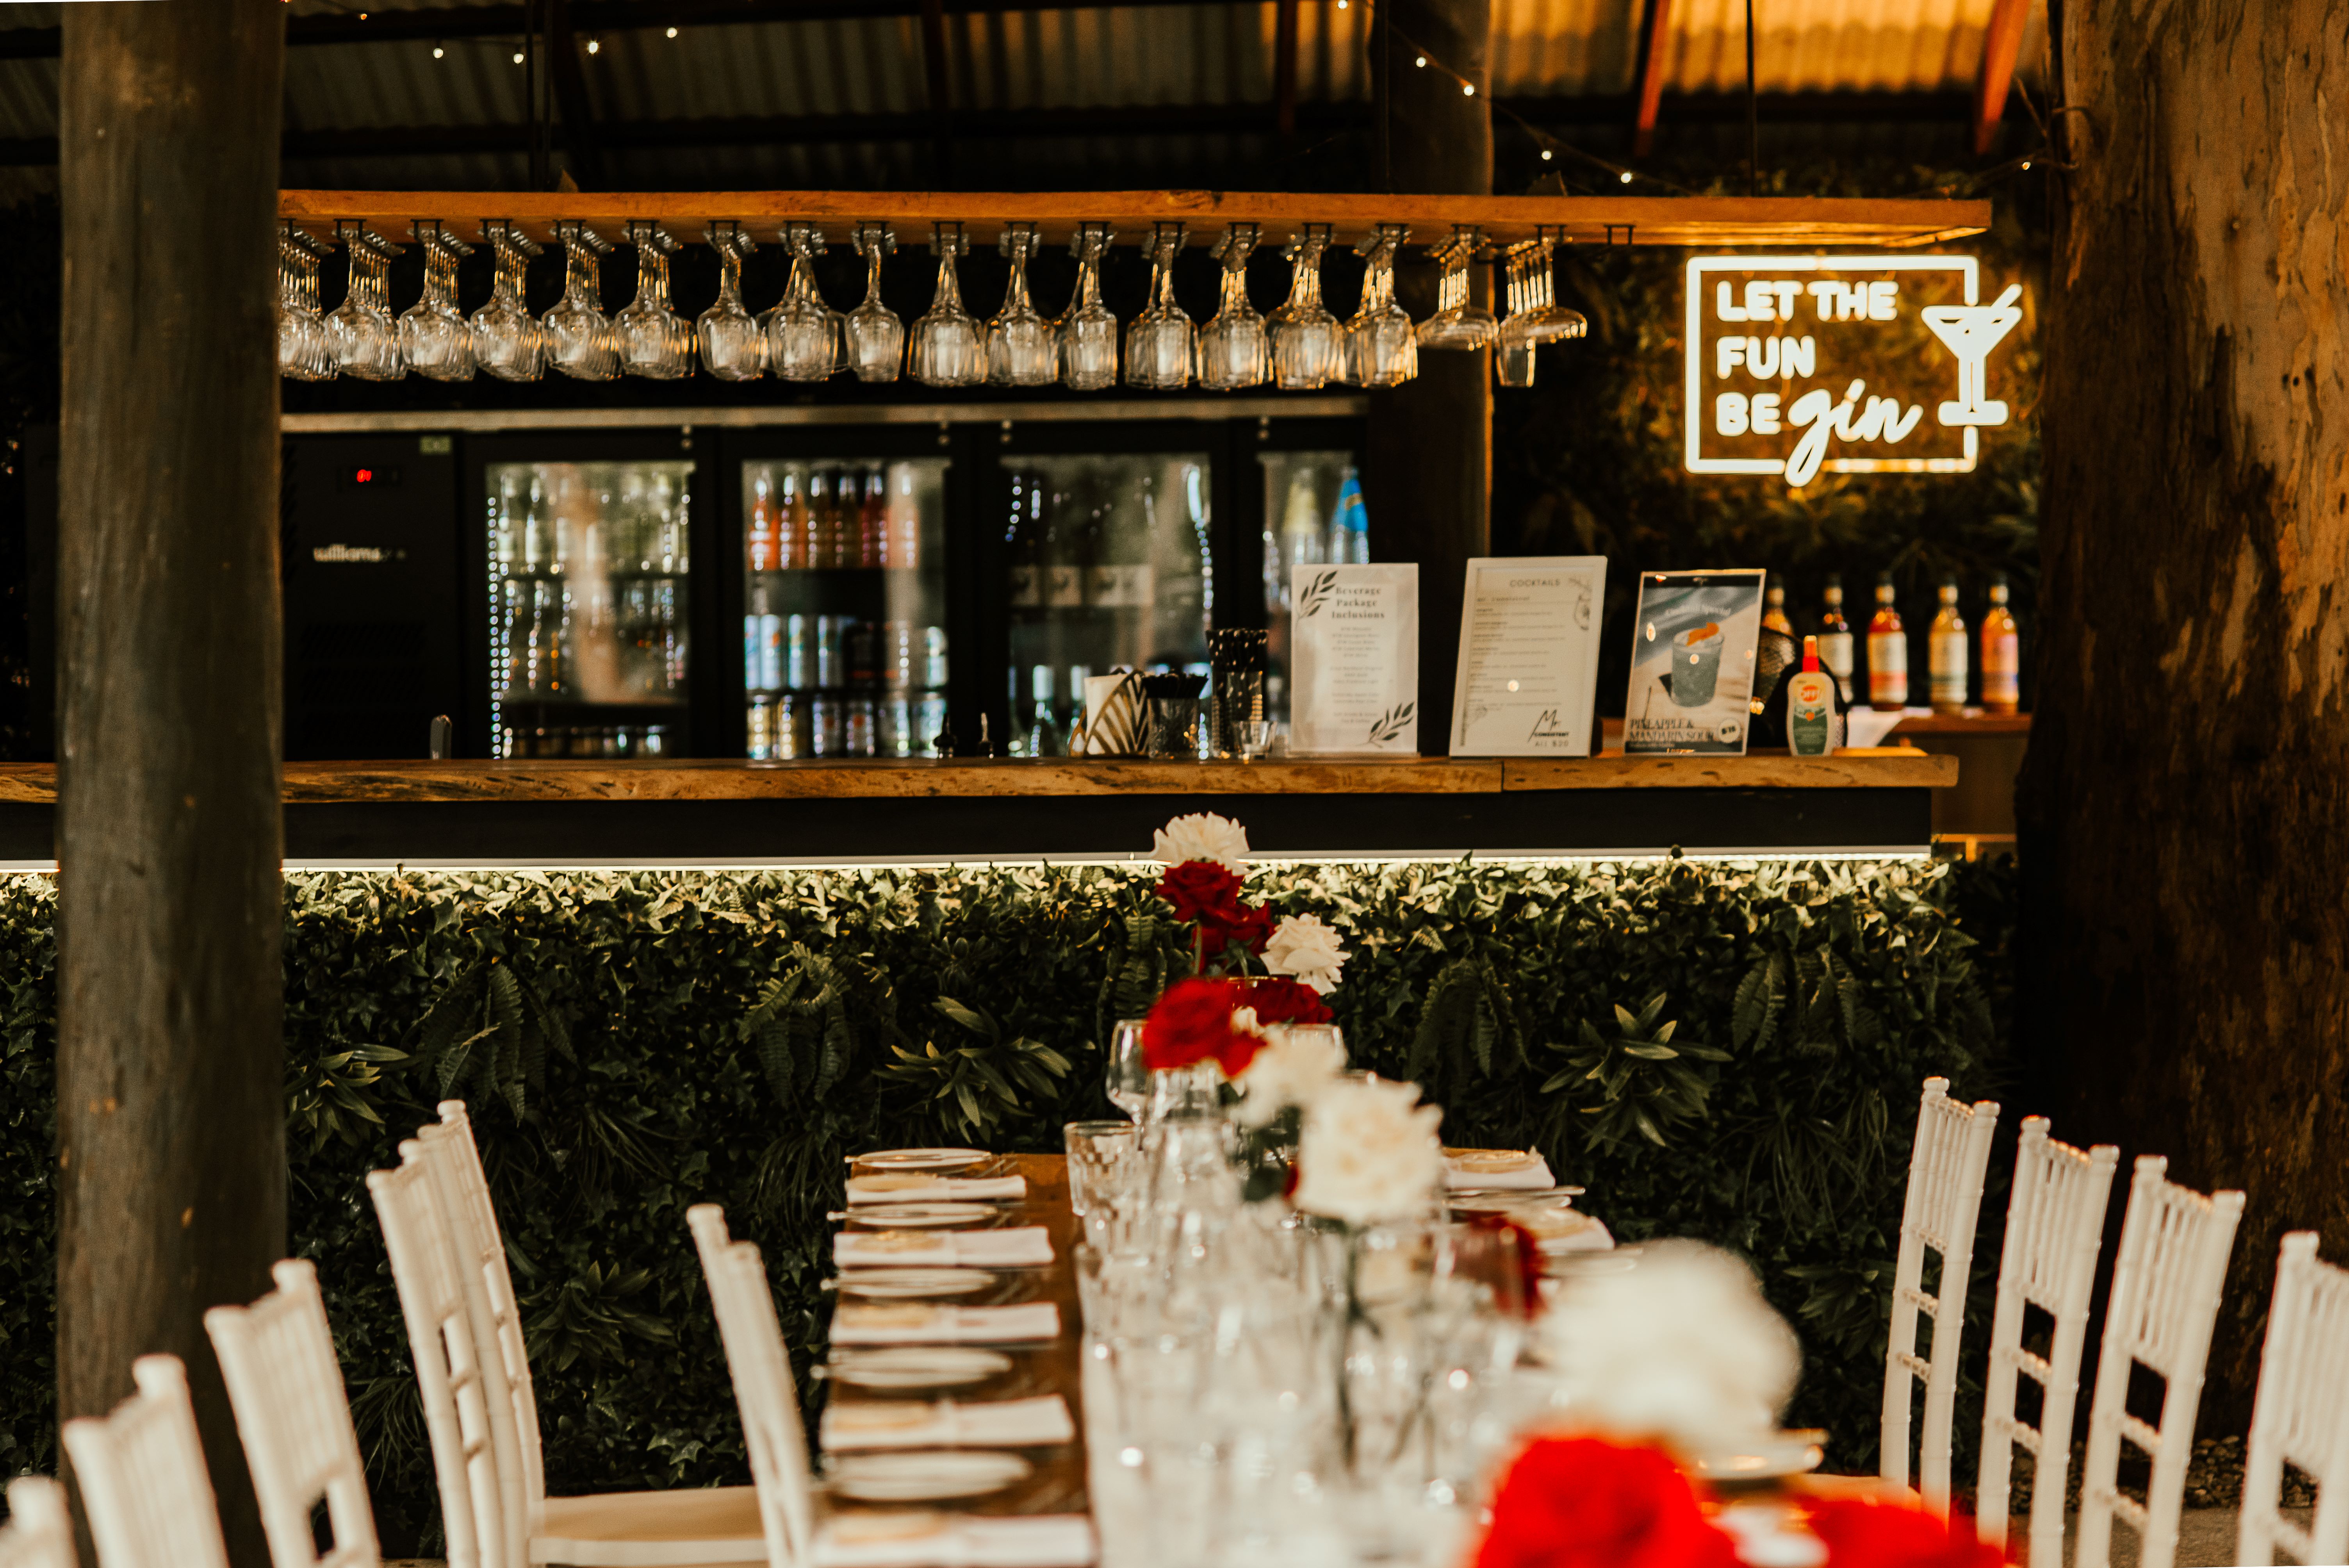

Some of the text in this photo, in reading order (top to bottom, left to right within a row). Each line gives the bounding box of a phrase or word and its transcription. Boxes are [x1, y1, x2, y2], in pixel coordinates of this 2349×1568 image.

[1717, 281, 1898, 321] LET THE
[1717, 335, 1816, 379] FUN
[1716, 379, 1923, 487] BE gin
[1336, 587, 1381, 595] Beverage
[1510, 579, 1561, 587] COCKTAILS
[1337, 599, 1377, 608] Package
